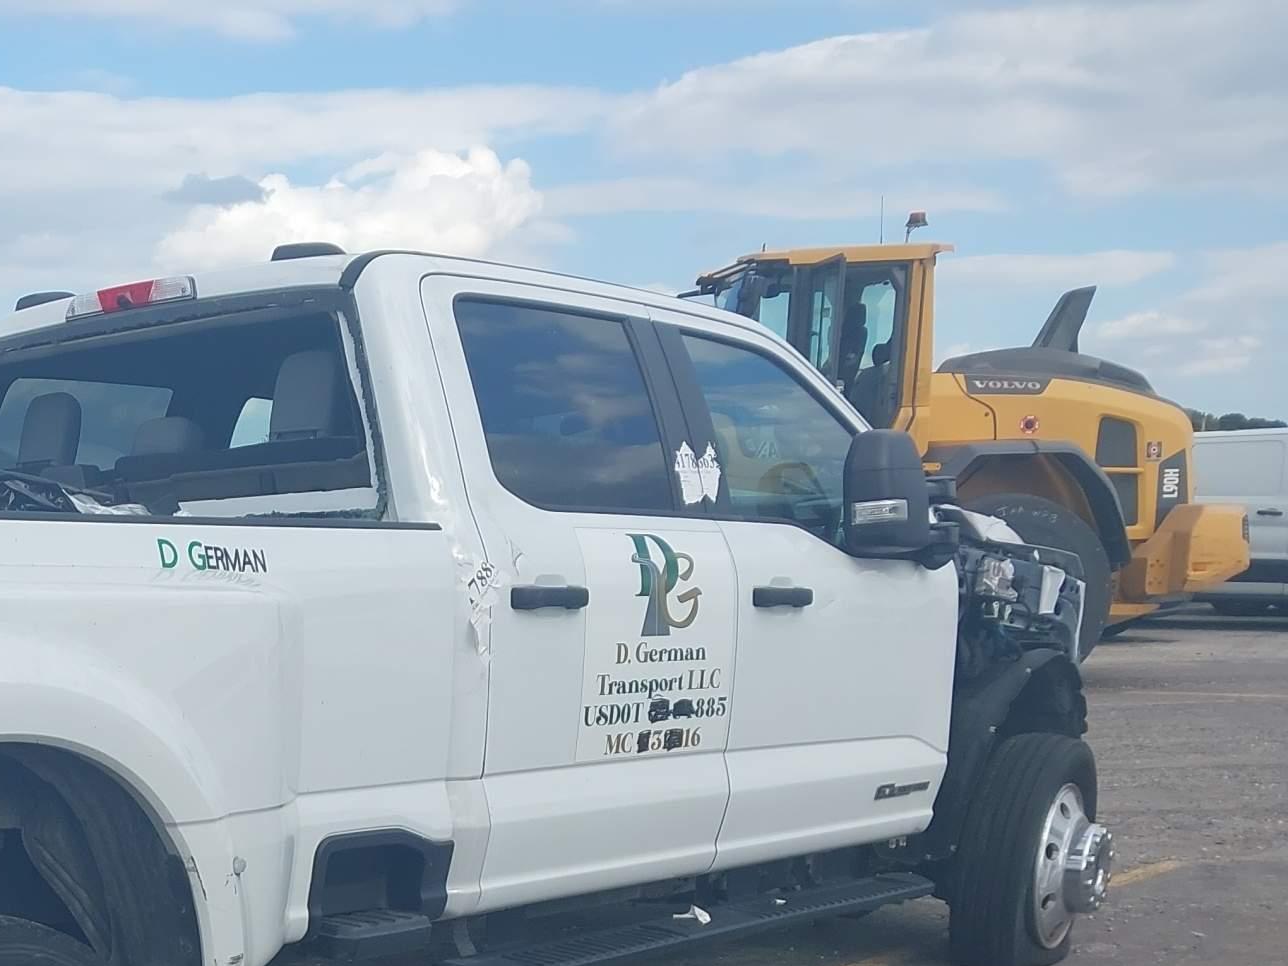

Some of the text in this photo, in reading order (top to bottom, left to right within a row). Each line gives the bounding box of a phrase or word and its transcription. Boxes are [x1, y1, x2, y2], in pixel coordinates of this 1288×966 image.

[973, 380, 1041, 390] VOLVO
[1162, 468, 1180, 498] L90H
[157, 538, 267, 573] D GERMAN
[615, 642, 706, 664] D. German
[597, 668, 721, 699] Transport LLC
[584, 702, 644, 727] USDOT
[604, 732, 633, 755] MC
